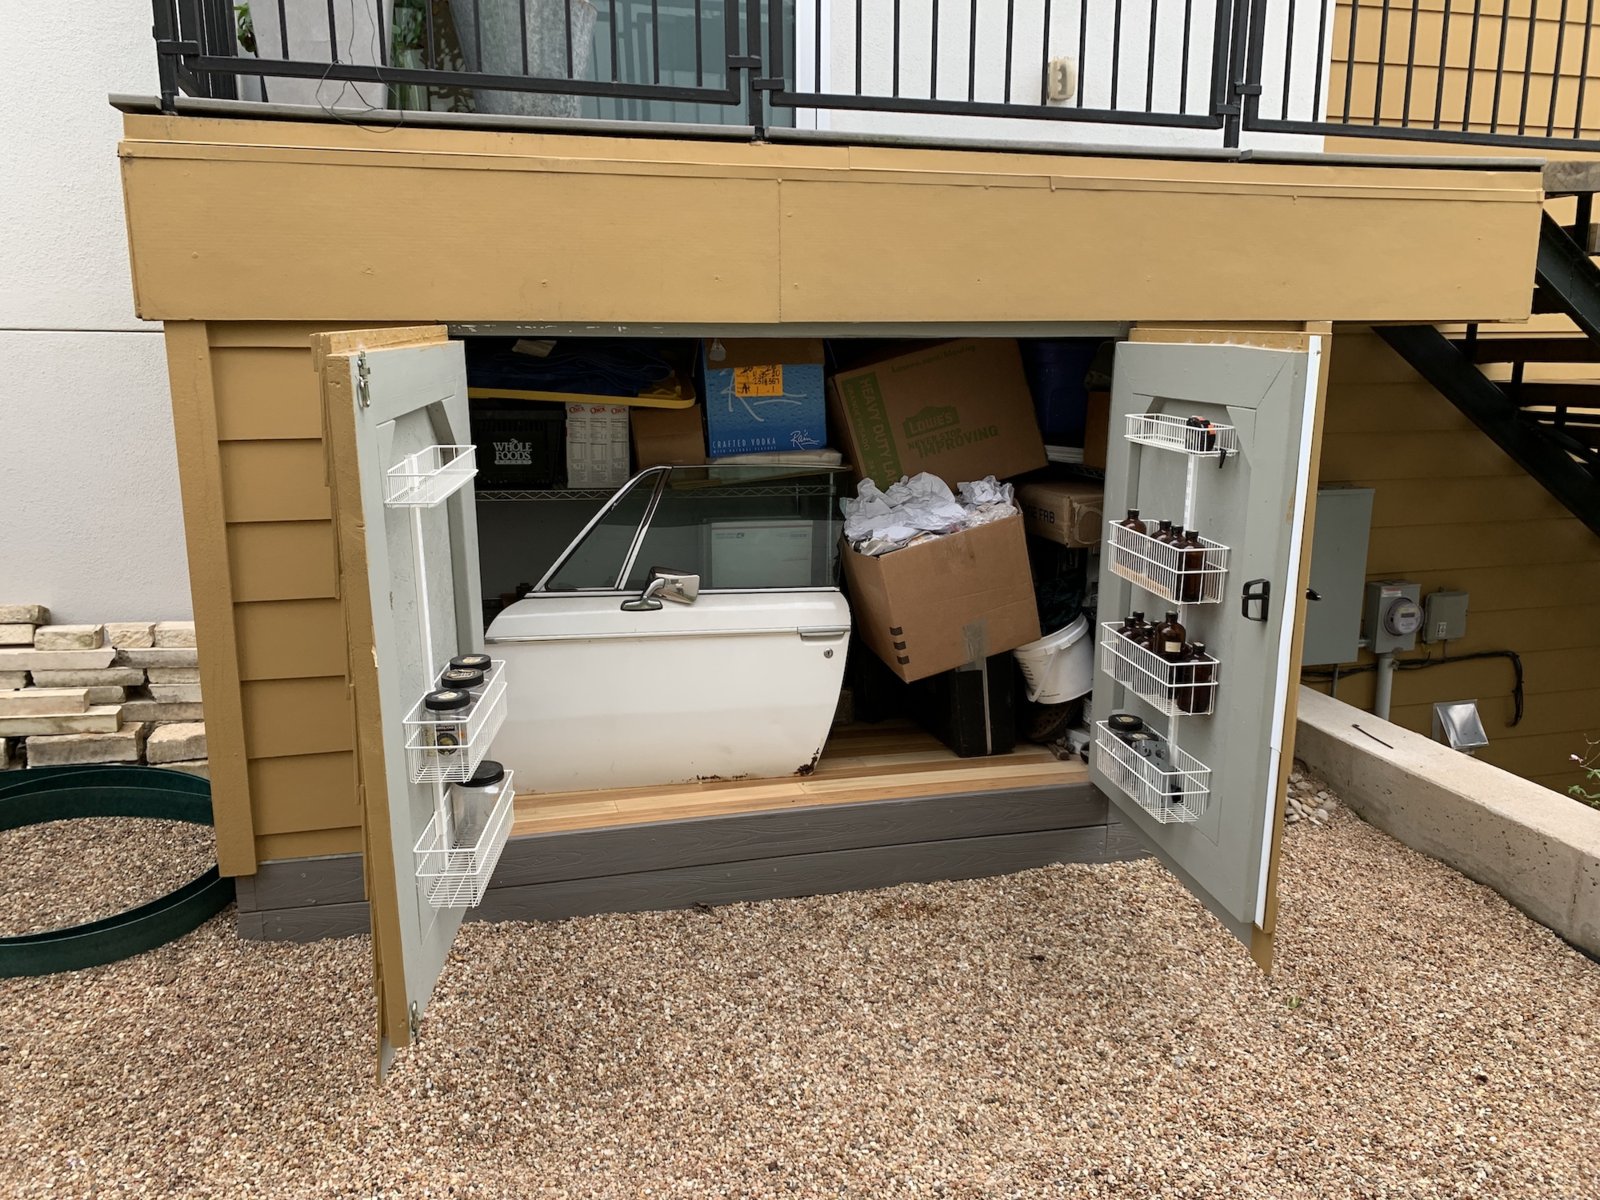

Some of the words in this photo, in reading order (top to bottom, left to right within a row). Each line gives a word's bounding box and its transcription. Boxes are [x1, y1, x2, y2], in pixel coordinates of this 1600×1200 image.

[859, 378, 881, 421] HEAVY
[872, 424, 892, 457] DUTY
[939, 428, 962, 440] STOP
[493, 441, 532, 451] WHOLE
[712, 439, 747, 449] CRAFTED
[751, 437, 776, 446] VODKA
[918, 424, 1000, 458] IMPROVING
[495, 451, 531, 460] FOODS
